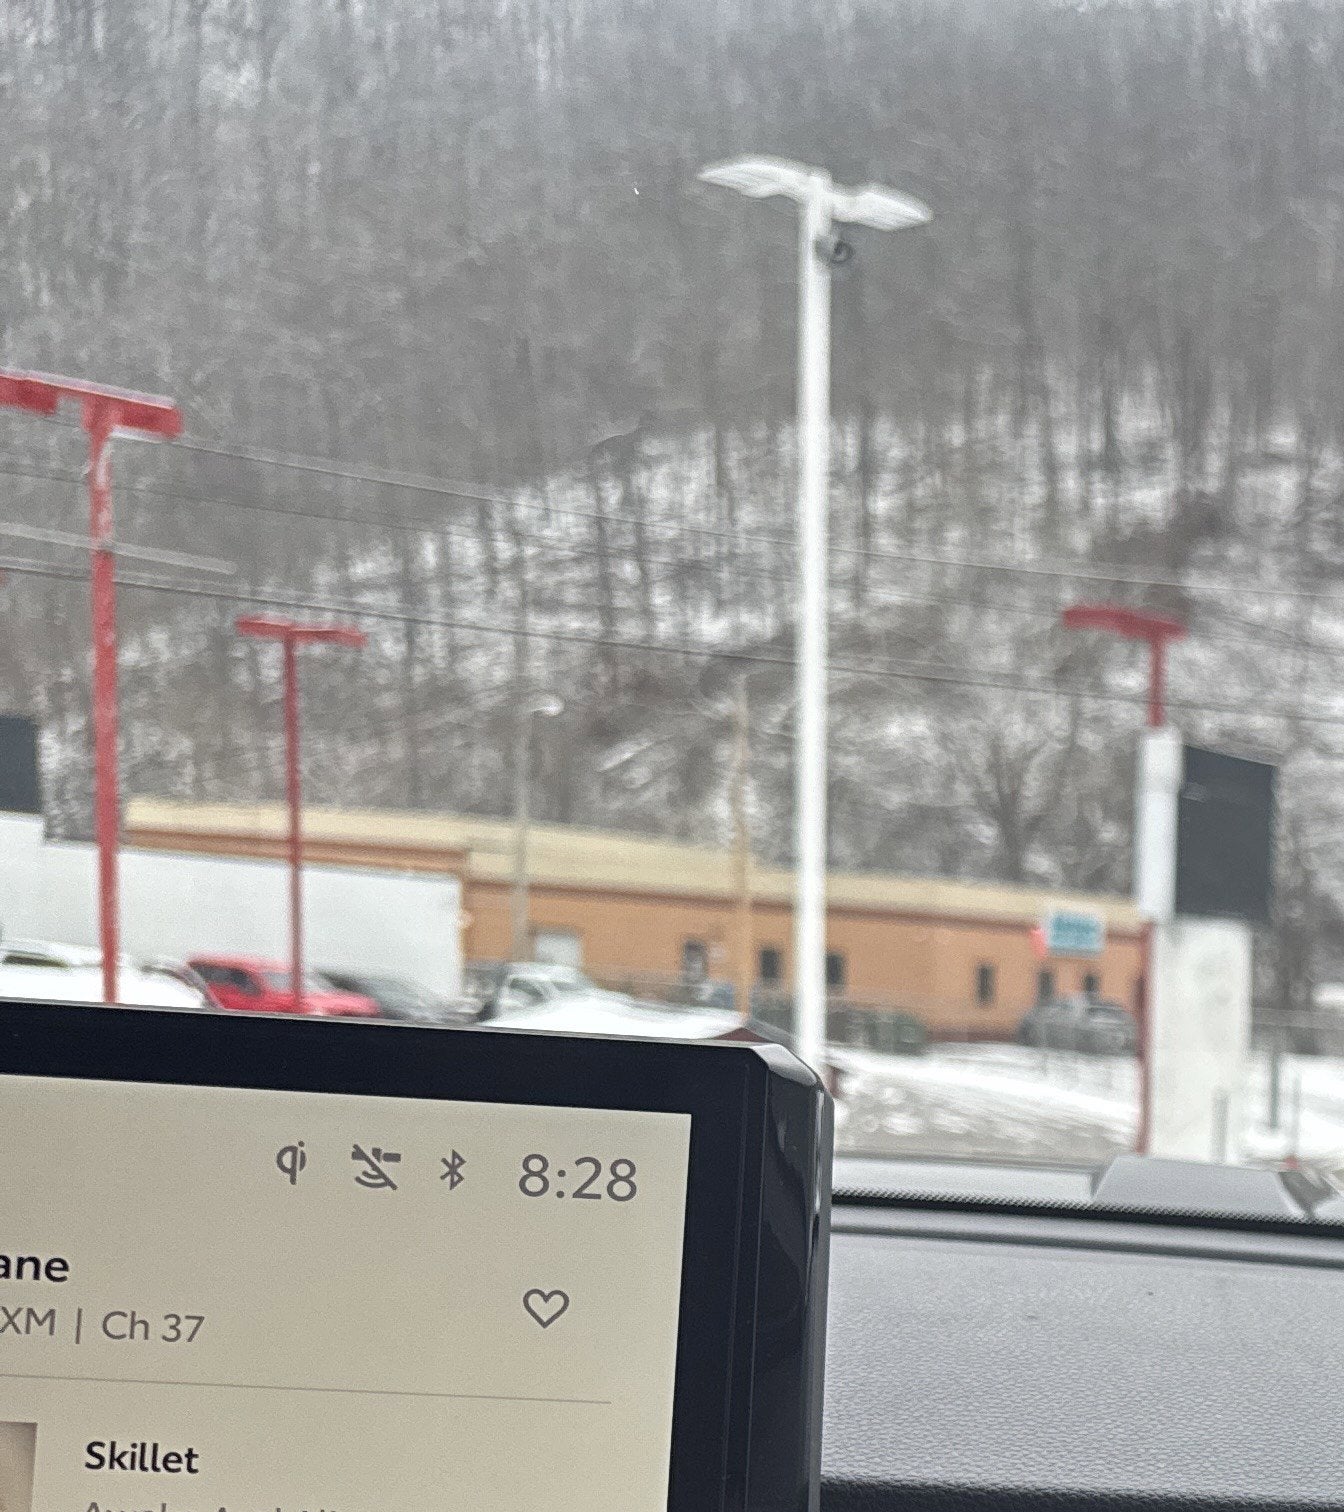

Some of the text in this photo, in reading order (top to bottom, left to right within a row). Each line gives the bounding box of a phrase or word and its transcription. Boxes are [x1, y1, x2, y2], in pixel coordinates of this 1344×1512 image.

[518, 1153, 638, 1202] 8:28
[0, 1306, 56, 1336] XM
[102, 1310, 150, 1341] Ch
[161, 1313, 205, 1343] 37
[84, 1441, 200, 1475] Skillet
